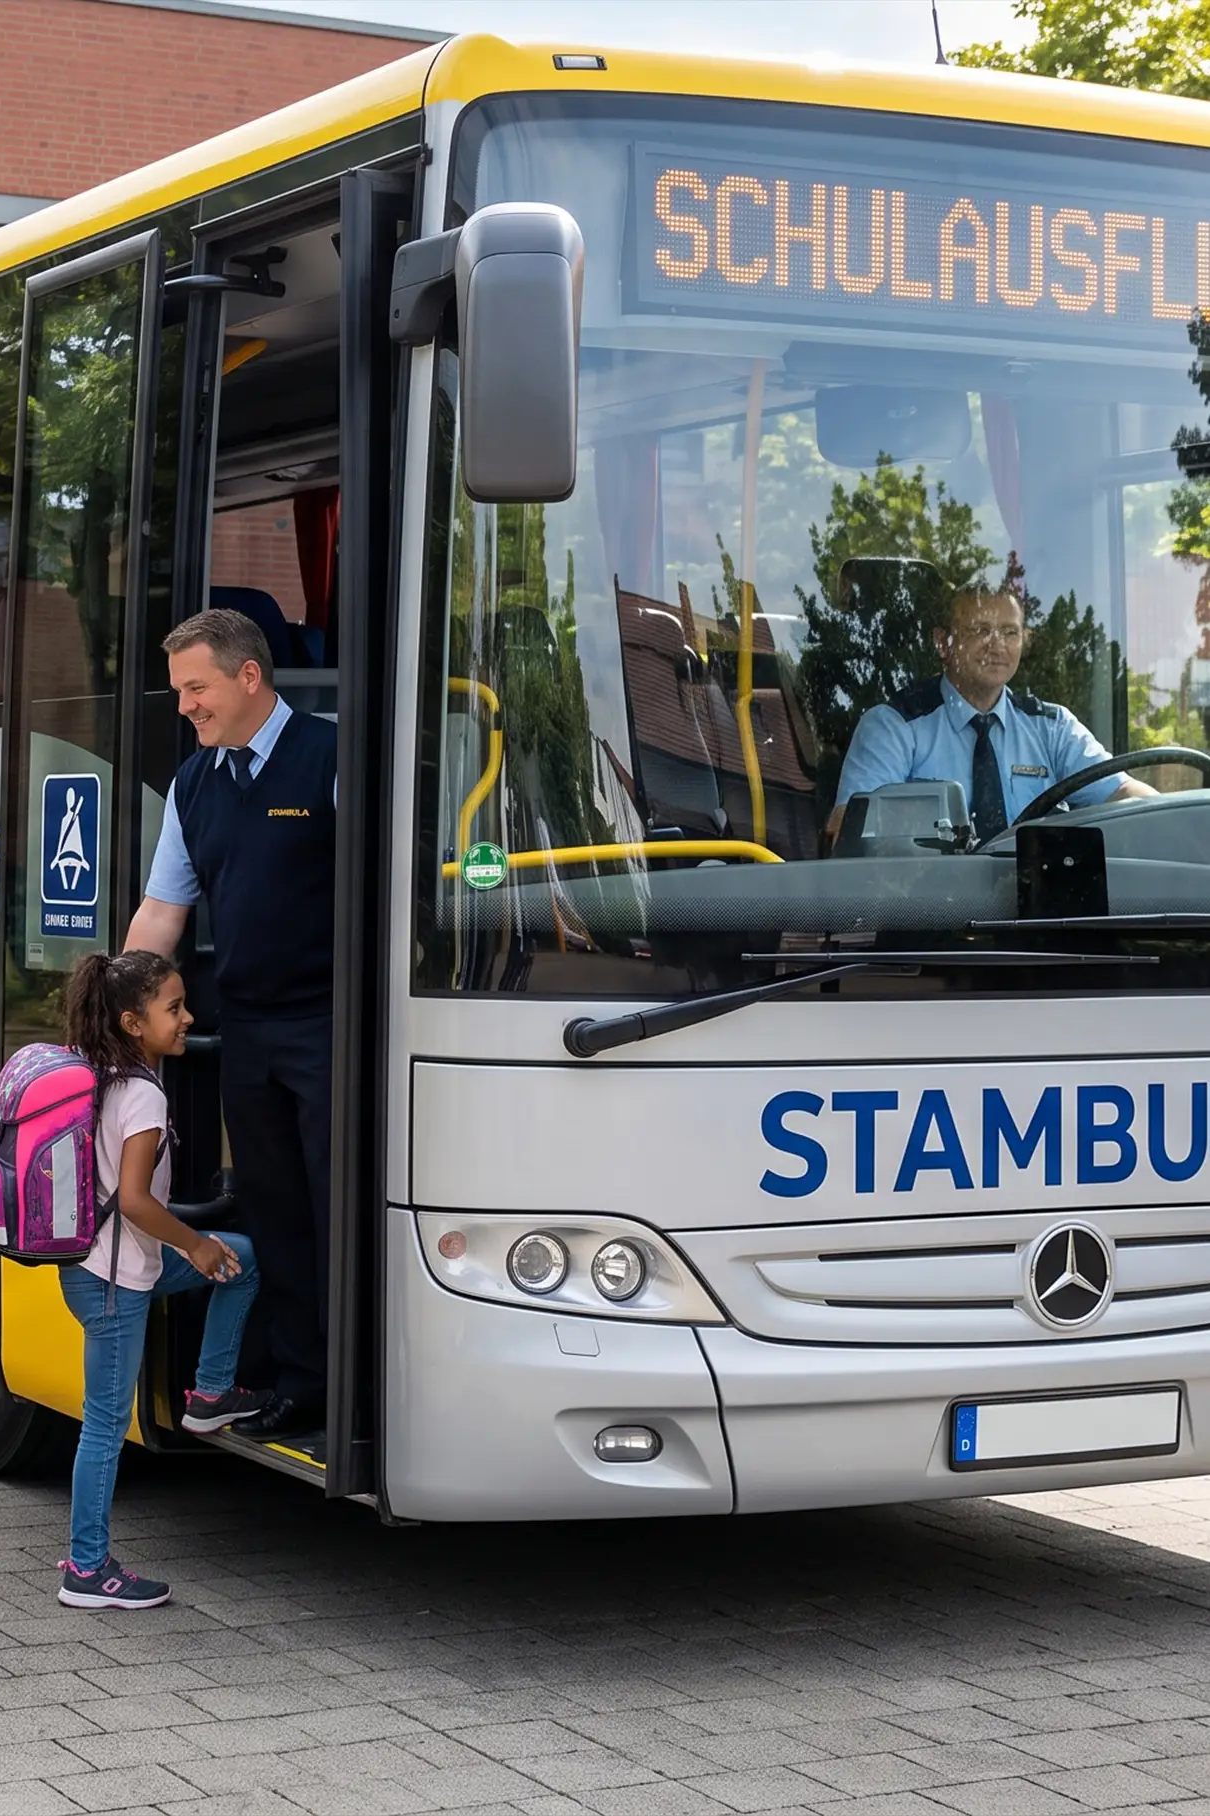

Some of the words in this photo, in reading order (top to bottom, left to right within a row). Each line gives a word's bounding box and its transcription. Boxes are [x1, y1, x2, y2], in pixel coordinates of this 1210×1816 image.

[654, 168, 1210, 322] SCHULAUSFL
[759, 1082, 1208, 1198] STAMBU
[961, 1439, 971, 1451] D
